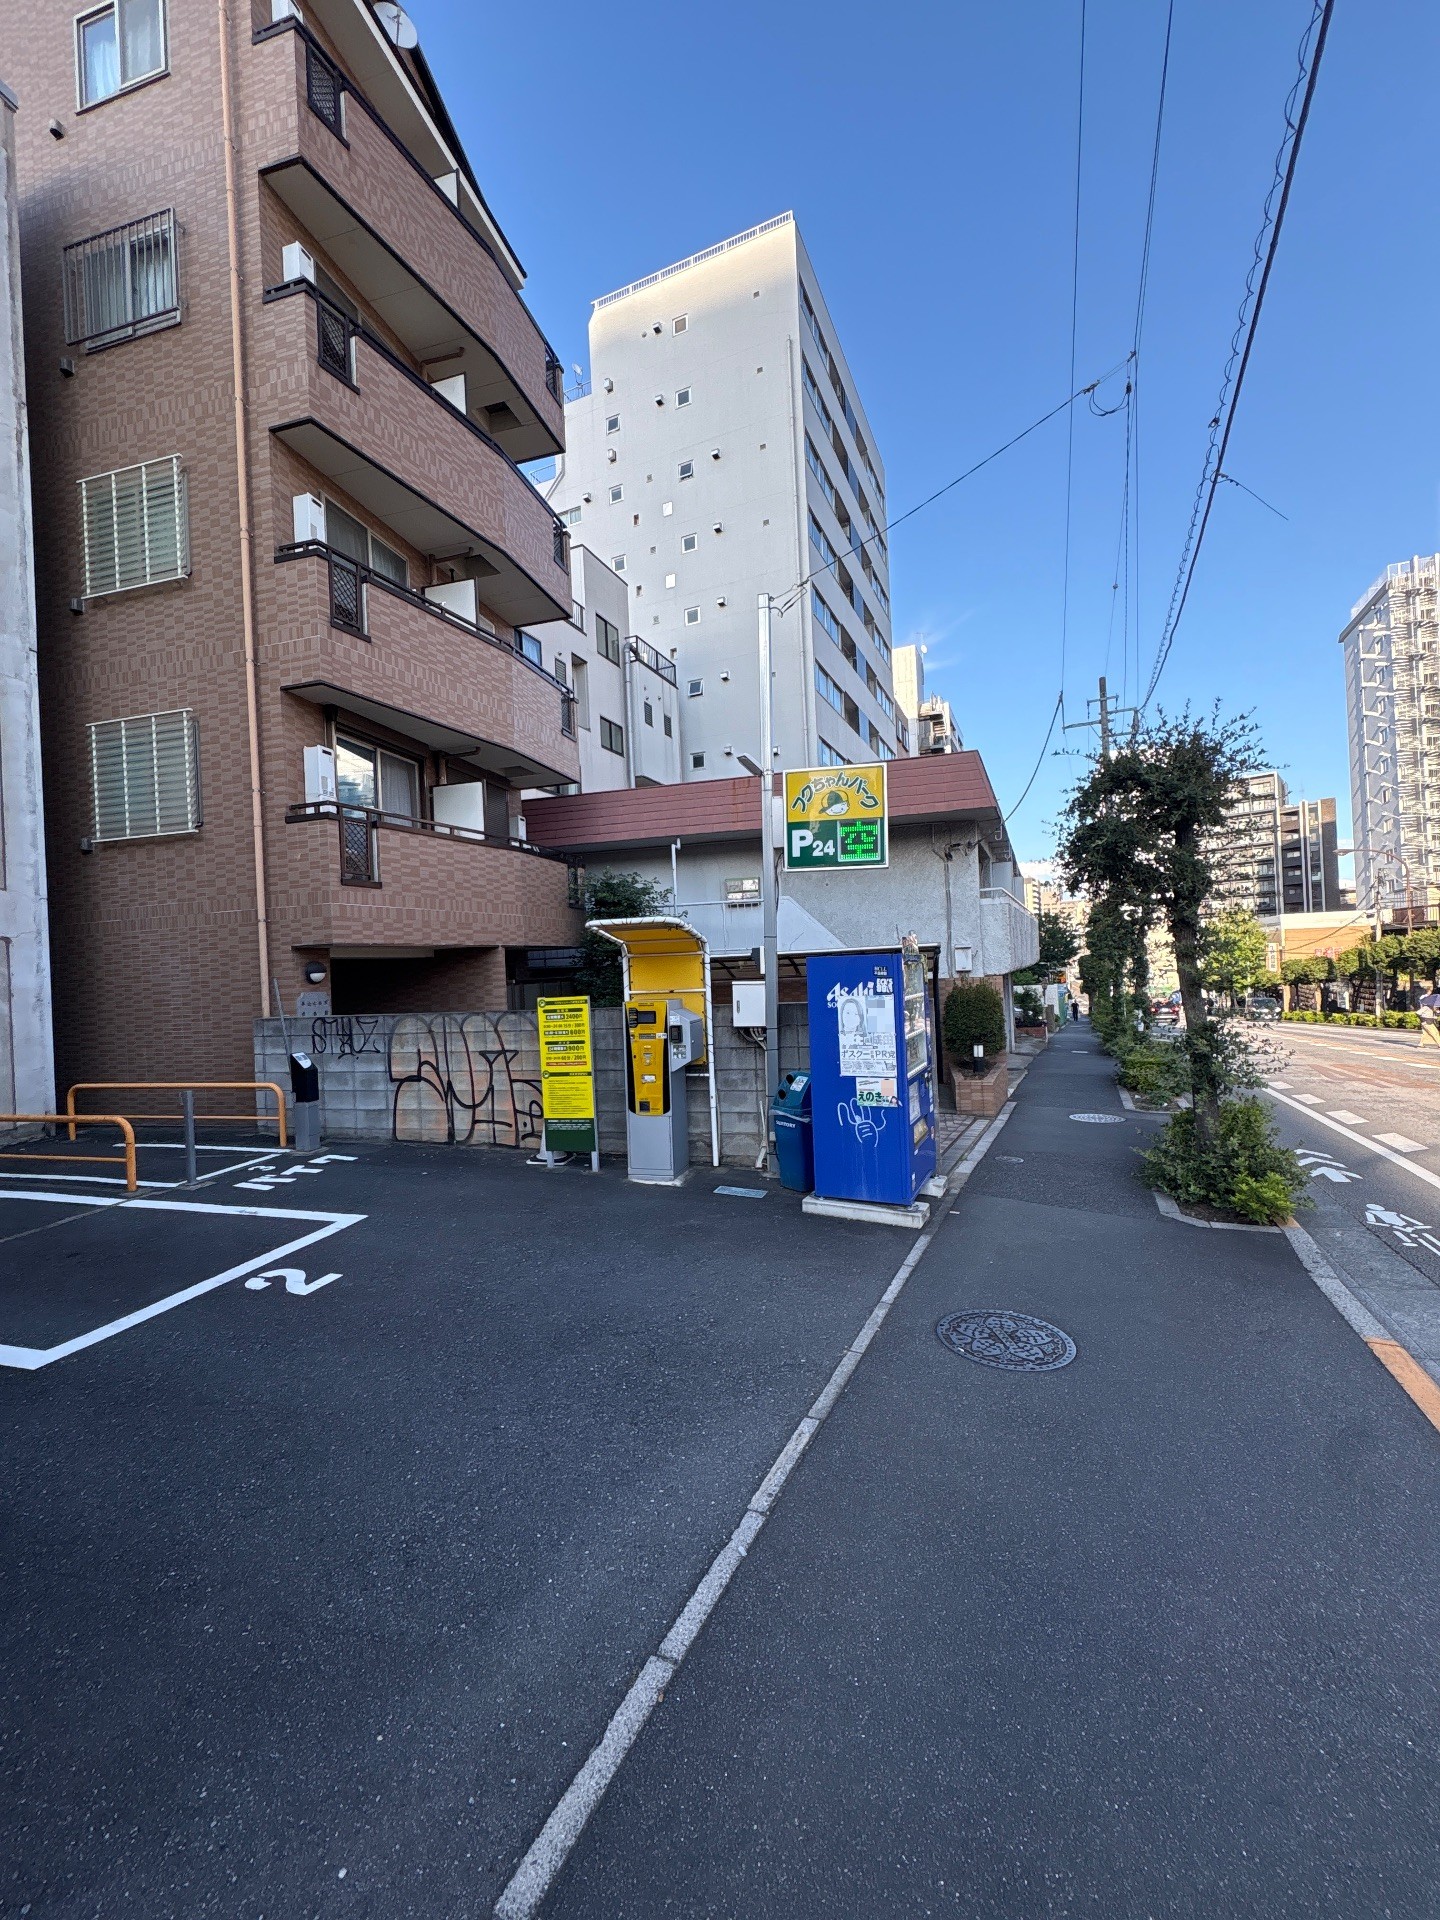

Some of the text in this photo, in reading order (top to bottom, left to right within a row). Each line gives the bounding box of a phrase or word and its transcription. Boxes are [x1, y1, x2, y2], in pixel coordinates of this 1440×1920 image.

[791, 772, 881, 813] フクちゃんパーク
[840, 821, 879, 860] 空
[244, 1268, 344, 1296] 2
